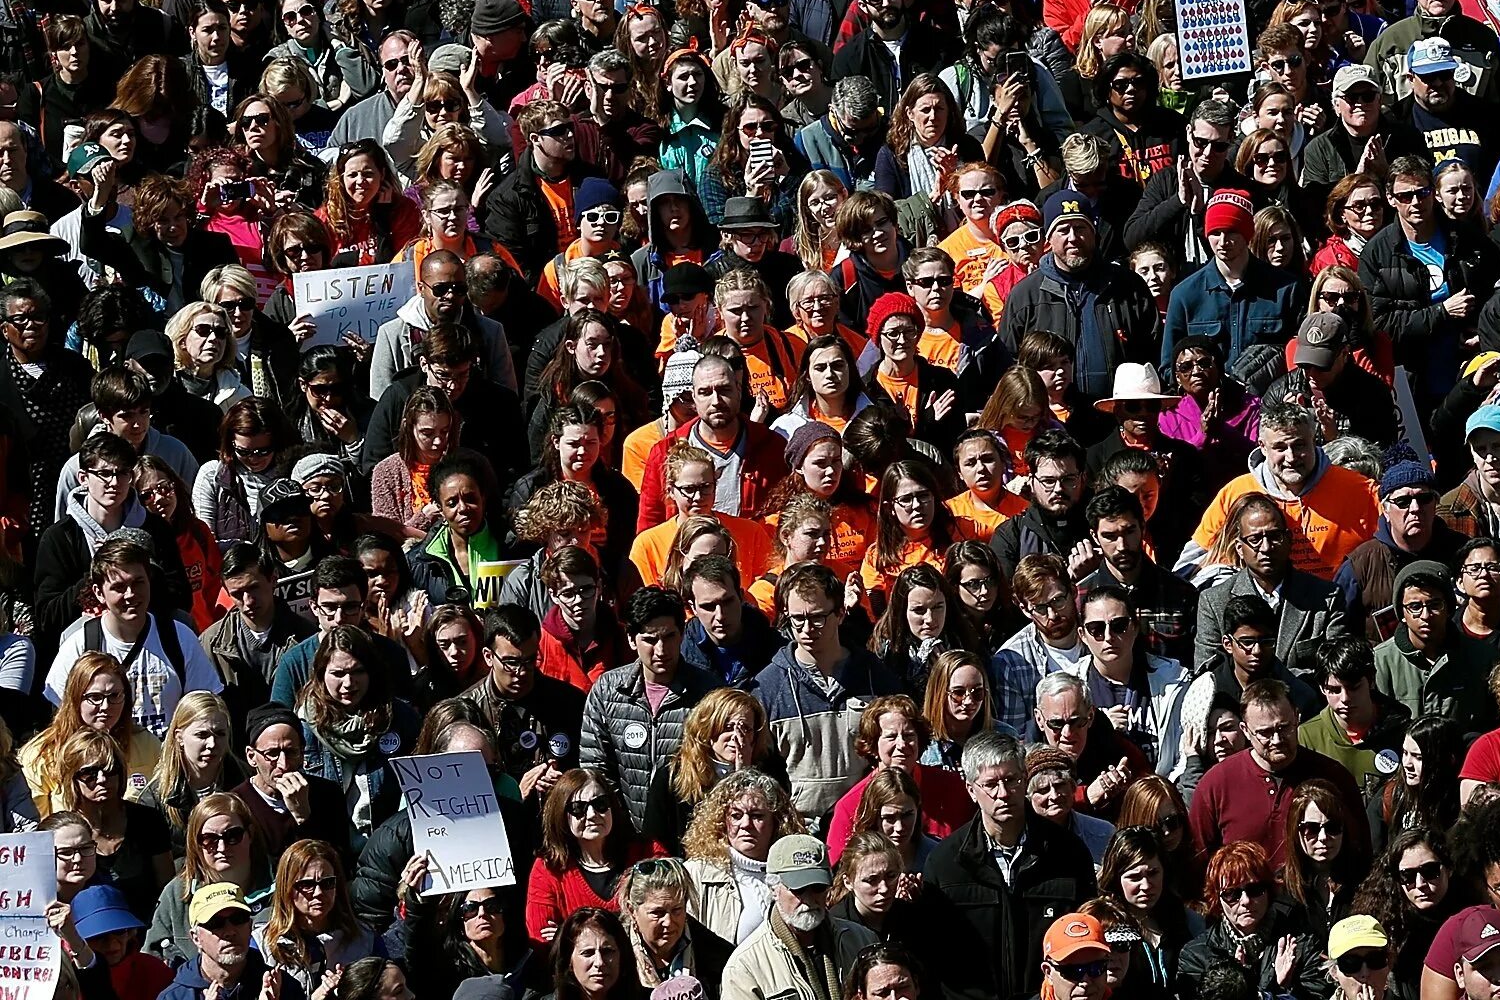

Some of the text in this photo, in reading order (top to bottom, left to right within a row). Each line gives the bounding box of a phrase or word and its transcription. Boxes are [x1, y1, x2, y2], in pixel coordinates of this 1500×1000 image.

[1061, 201, 1080, 213] M
[306, 272, 394, 304] LISTEN
[324, 296, 395, 320] TO THE
[1309, 524, 1329, 533] Lives
[381, 738, 398, 746] 2018
[626, 732, 643, 740] 2018
[394, 757, 464, 787] NOT
[405, 787, 493, 820] RIGHT
[427, 826, 449, 838] FOR
[426, 849, 515, 890] AMERICA
[5, 924, 51, 942] Change!
[1064, 921, 1091, 938] C
